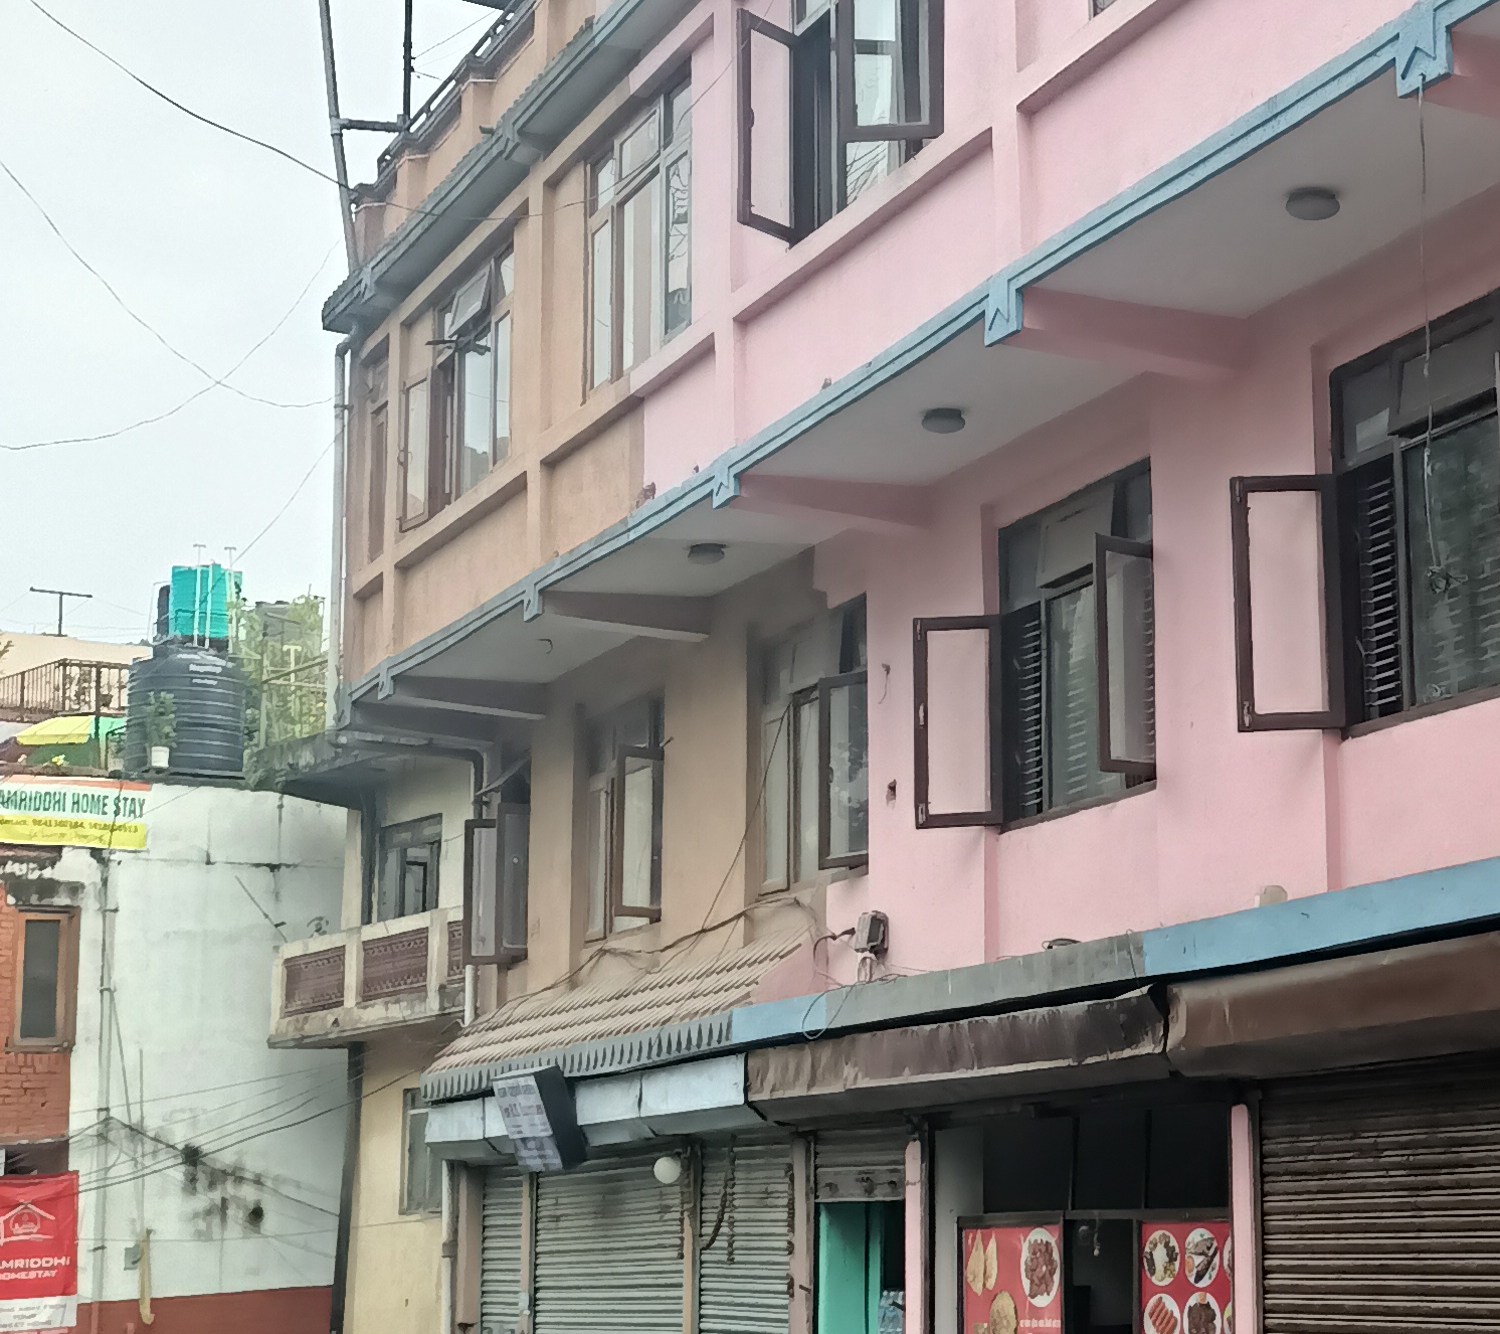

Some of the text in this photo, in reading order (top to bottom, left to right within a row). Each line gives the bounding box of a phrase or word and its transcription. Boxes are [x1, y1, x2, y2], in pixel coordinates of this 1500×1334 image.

[70, 792, 109, 816] HOME
[113, 795, 146, 819] STAY
[0, 1256, 71, 1270] MRIDDHI
